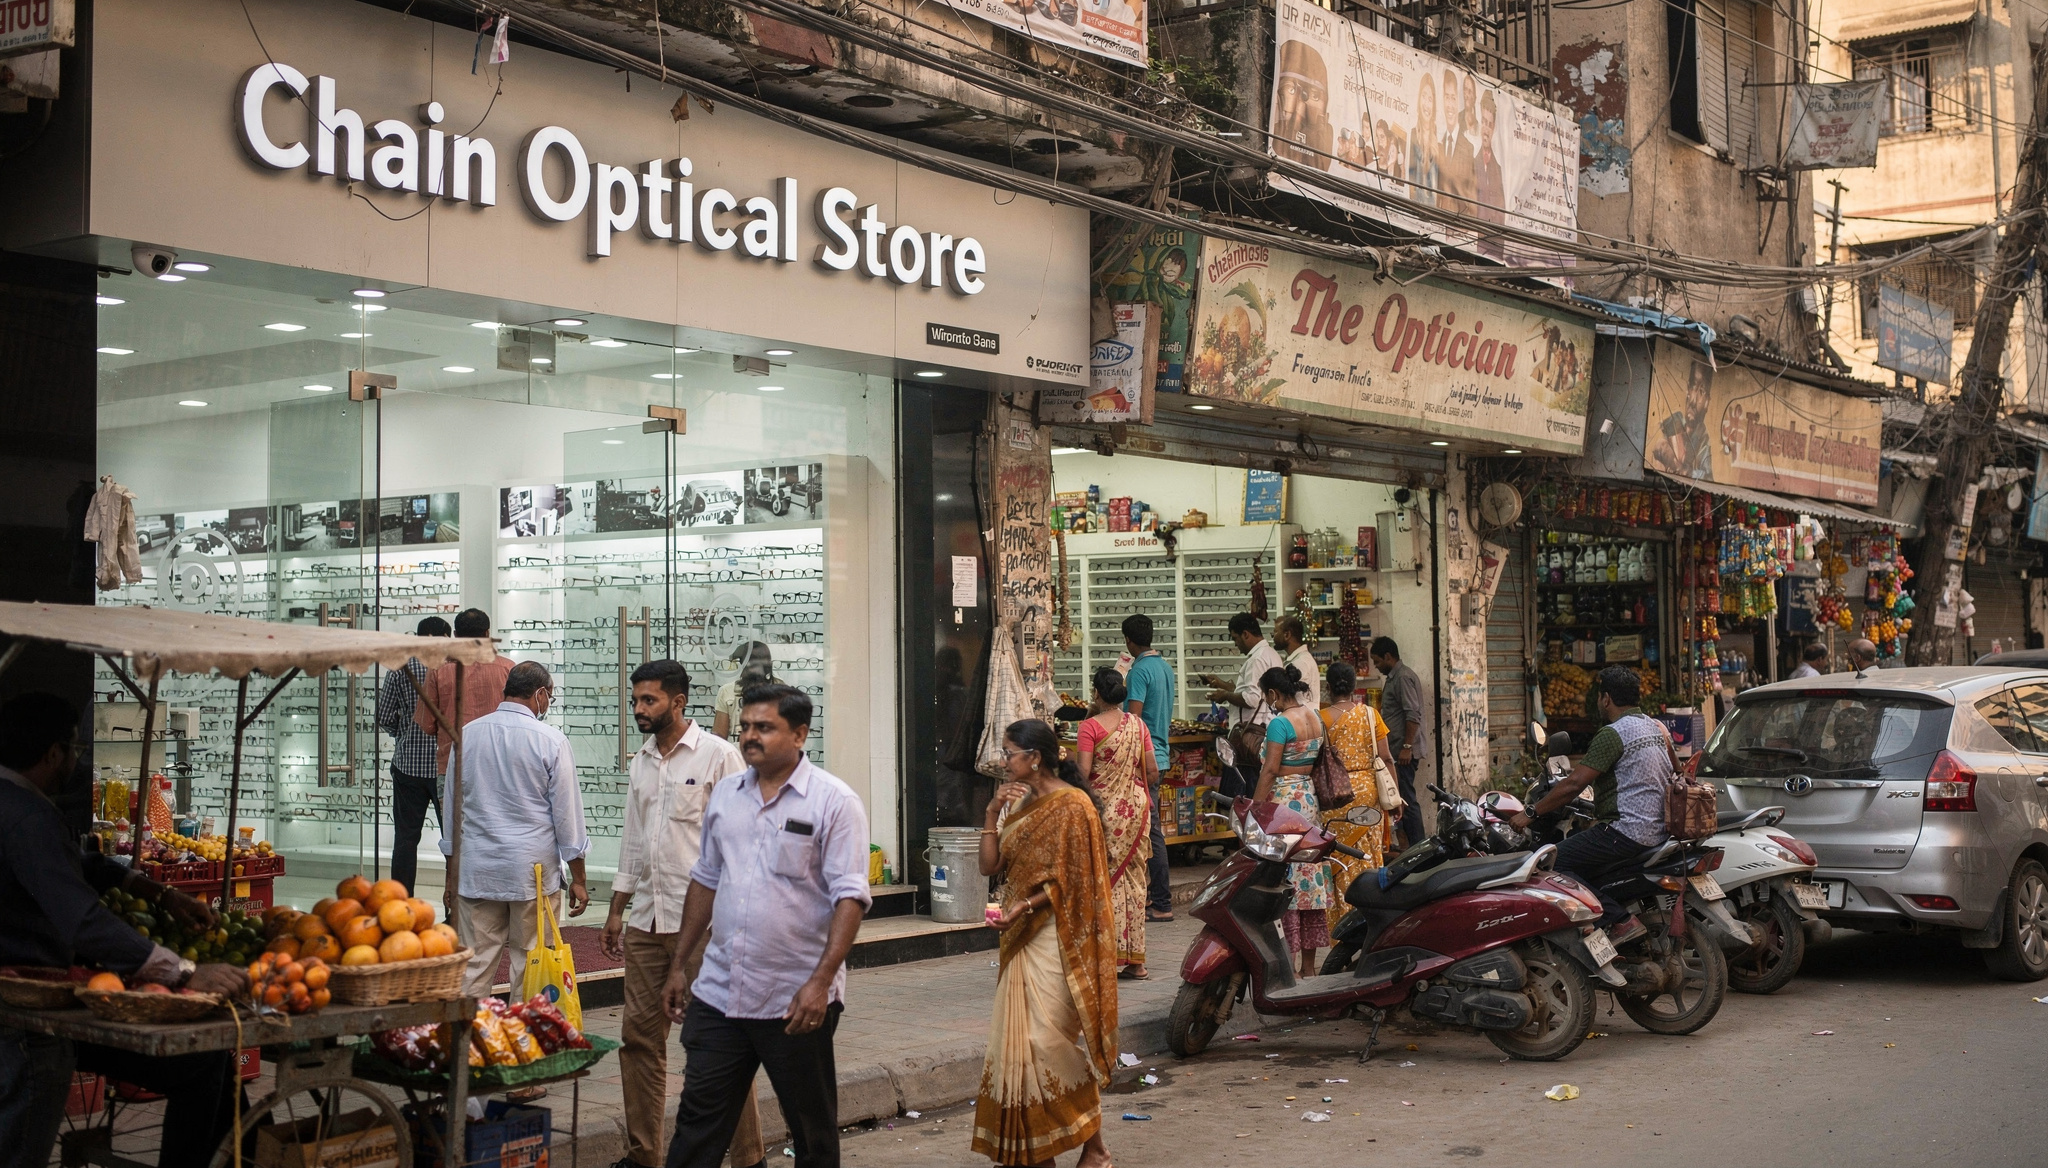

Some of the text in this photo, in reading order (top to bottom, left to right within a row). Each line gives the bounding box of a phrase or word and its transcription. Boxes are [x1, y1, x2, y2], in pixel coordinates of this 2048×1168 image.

[236, 62, 986, 295] Chain Optical Store
[1291, 268, 1518, 380] The Optician
